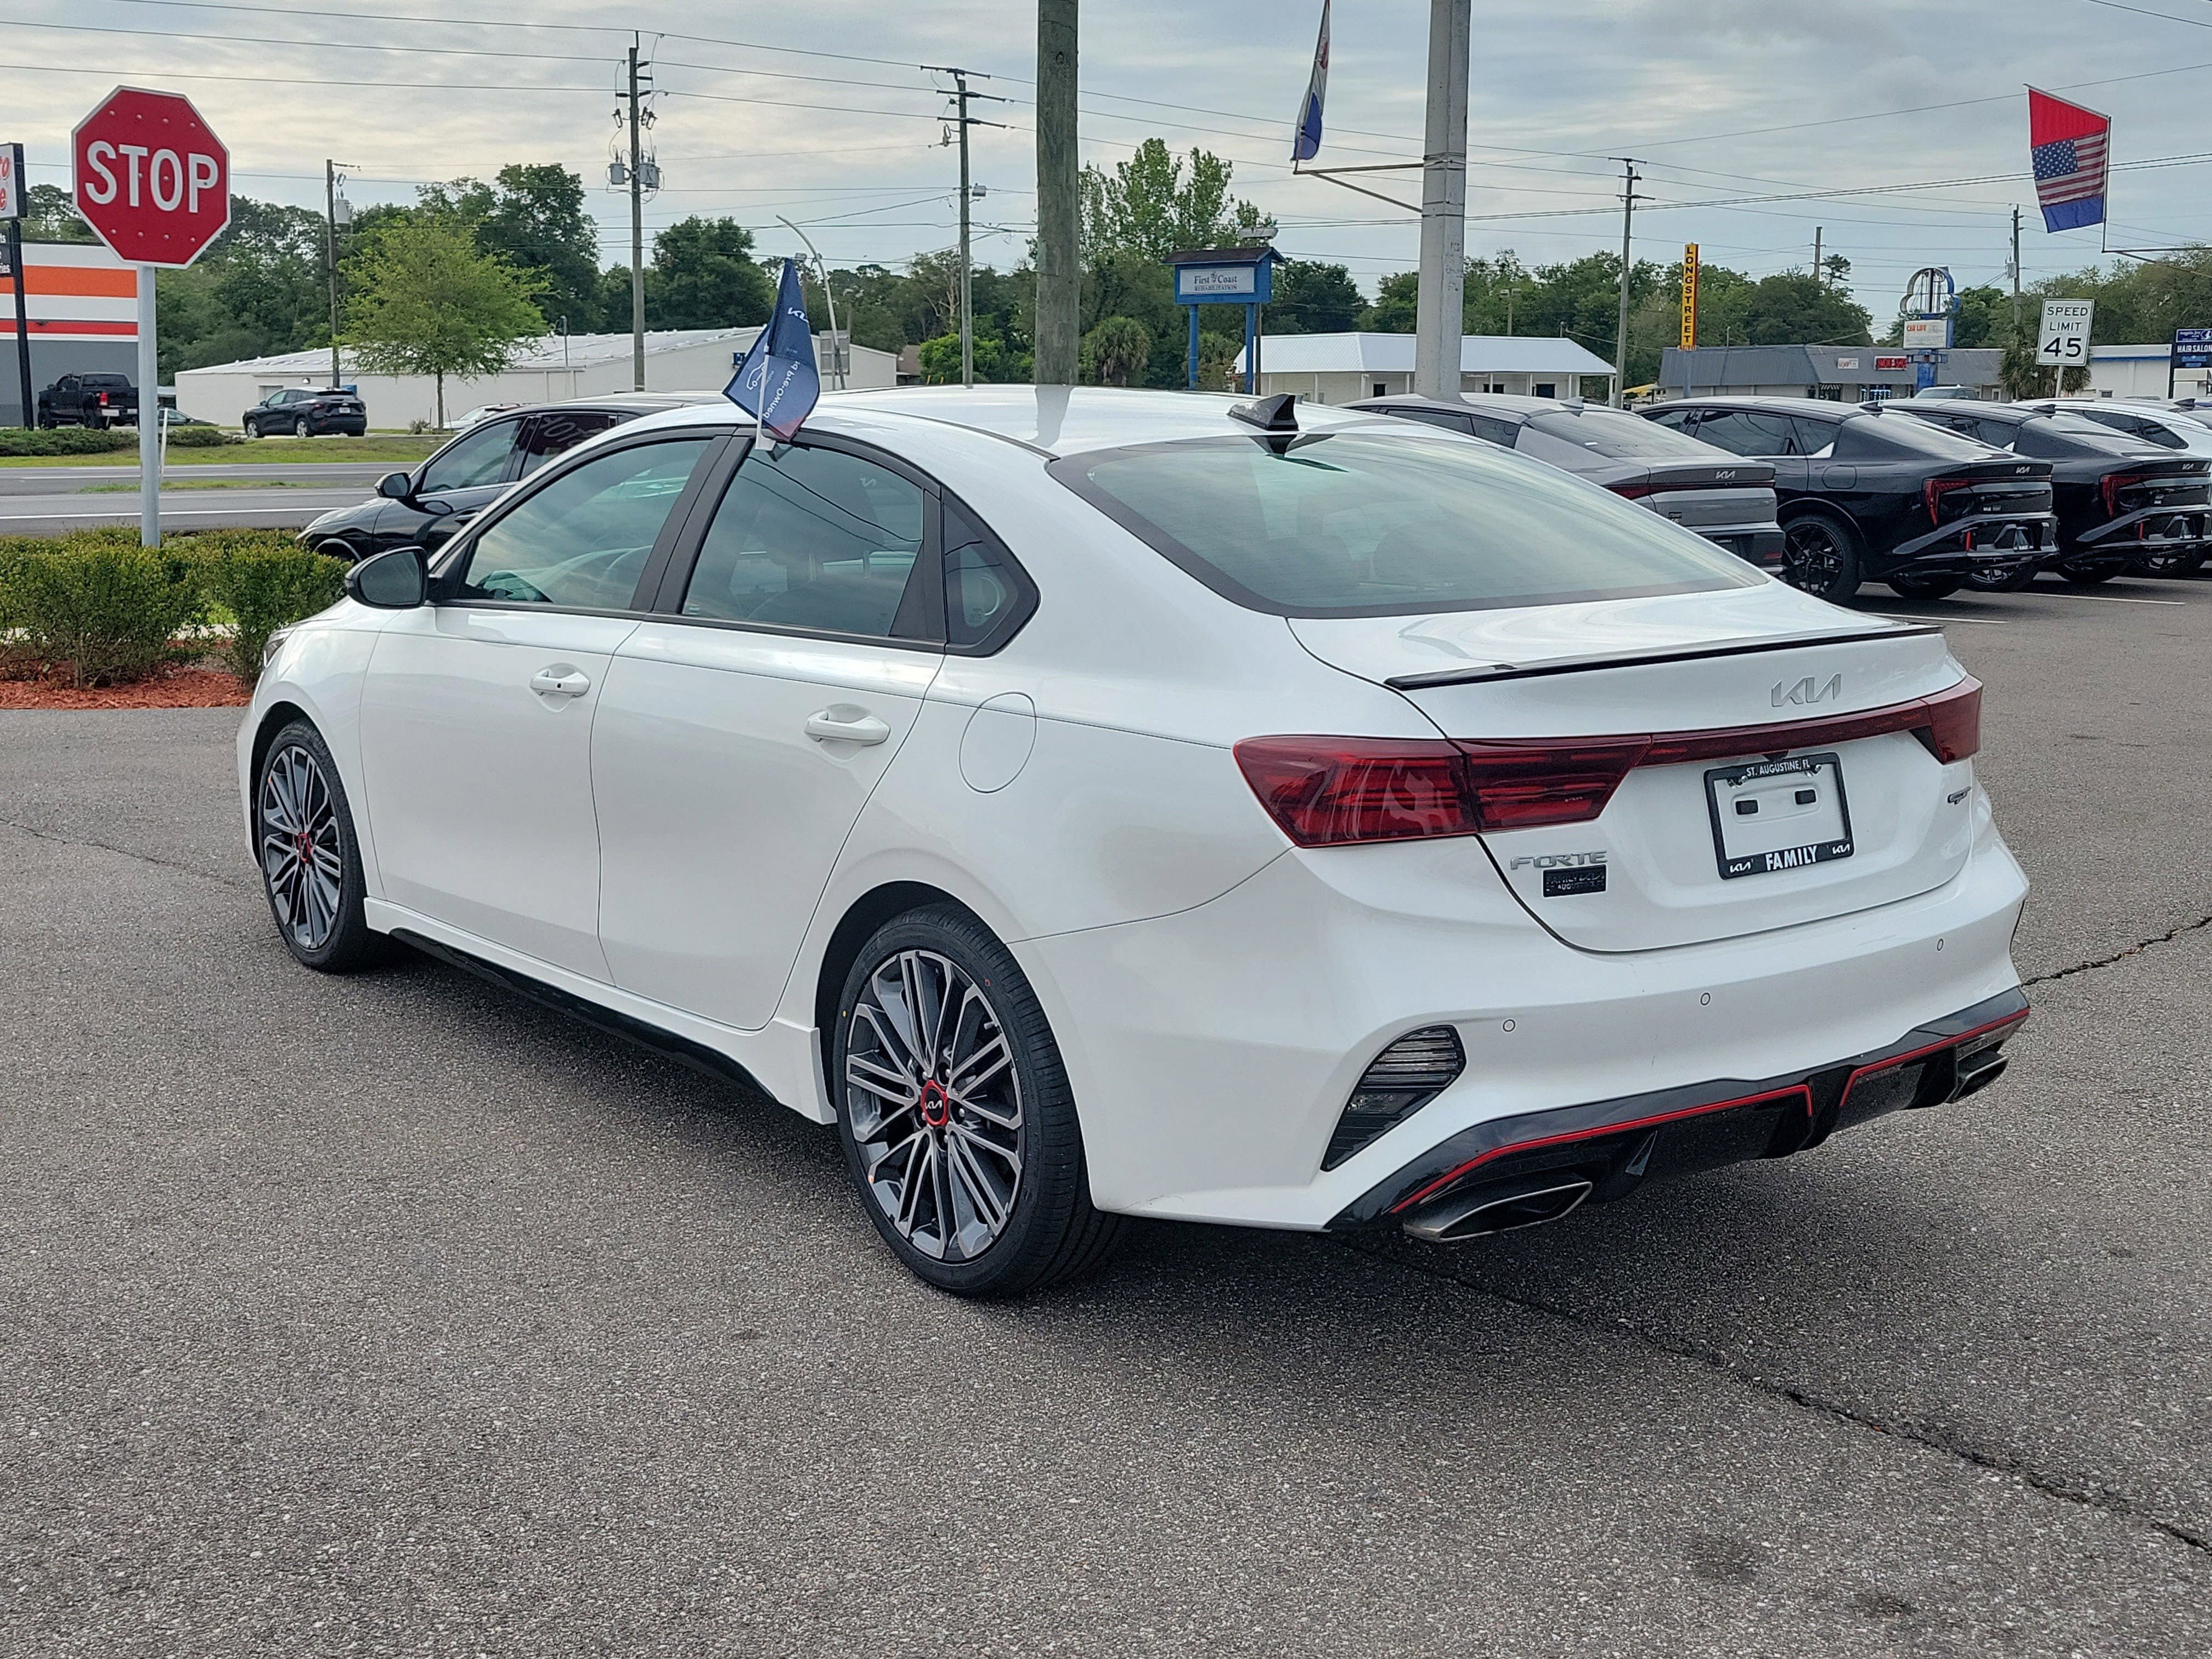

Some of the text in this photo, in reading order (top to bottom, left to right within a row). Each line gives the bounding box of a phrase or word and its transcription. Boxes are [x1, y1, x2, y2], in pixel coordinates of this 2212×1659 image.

[85, 140, 218, 213] STOP
[1194, 275, 1237, 284] First Coast
[1684, 246, 1694, 343] LONGSTREET
[2047, 307, 2088, 316] SPEED
[2049, 322, 2082, 331] LIMIT
[2044, 337, 2082, 358] 45
[1716, 470, 1735, 479] KIA
[1771, 673, 1842, 707] KIA
[1746, 759, 1810, 777] ST. AUGUSTINE, FL
[1510, 850, 1608, 870] FORTE
[1730, 844, 1850, 872] KIA FAMILY KIA
[924, 1099, 943, 1109] KIA
